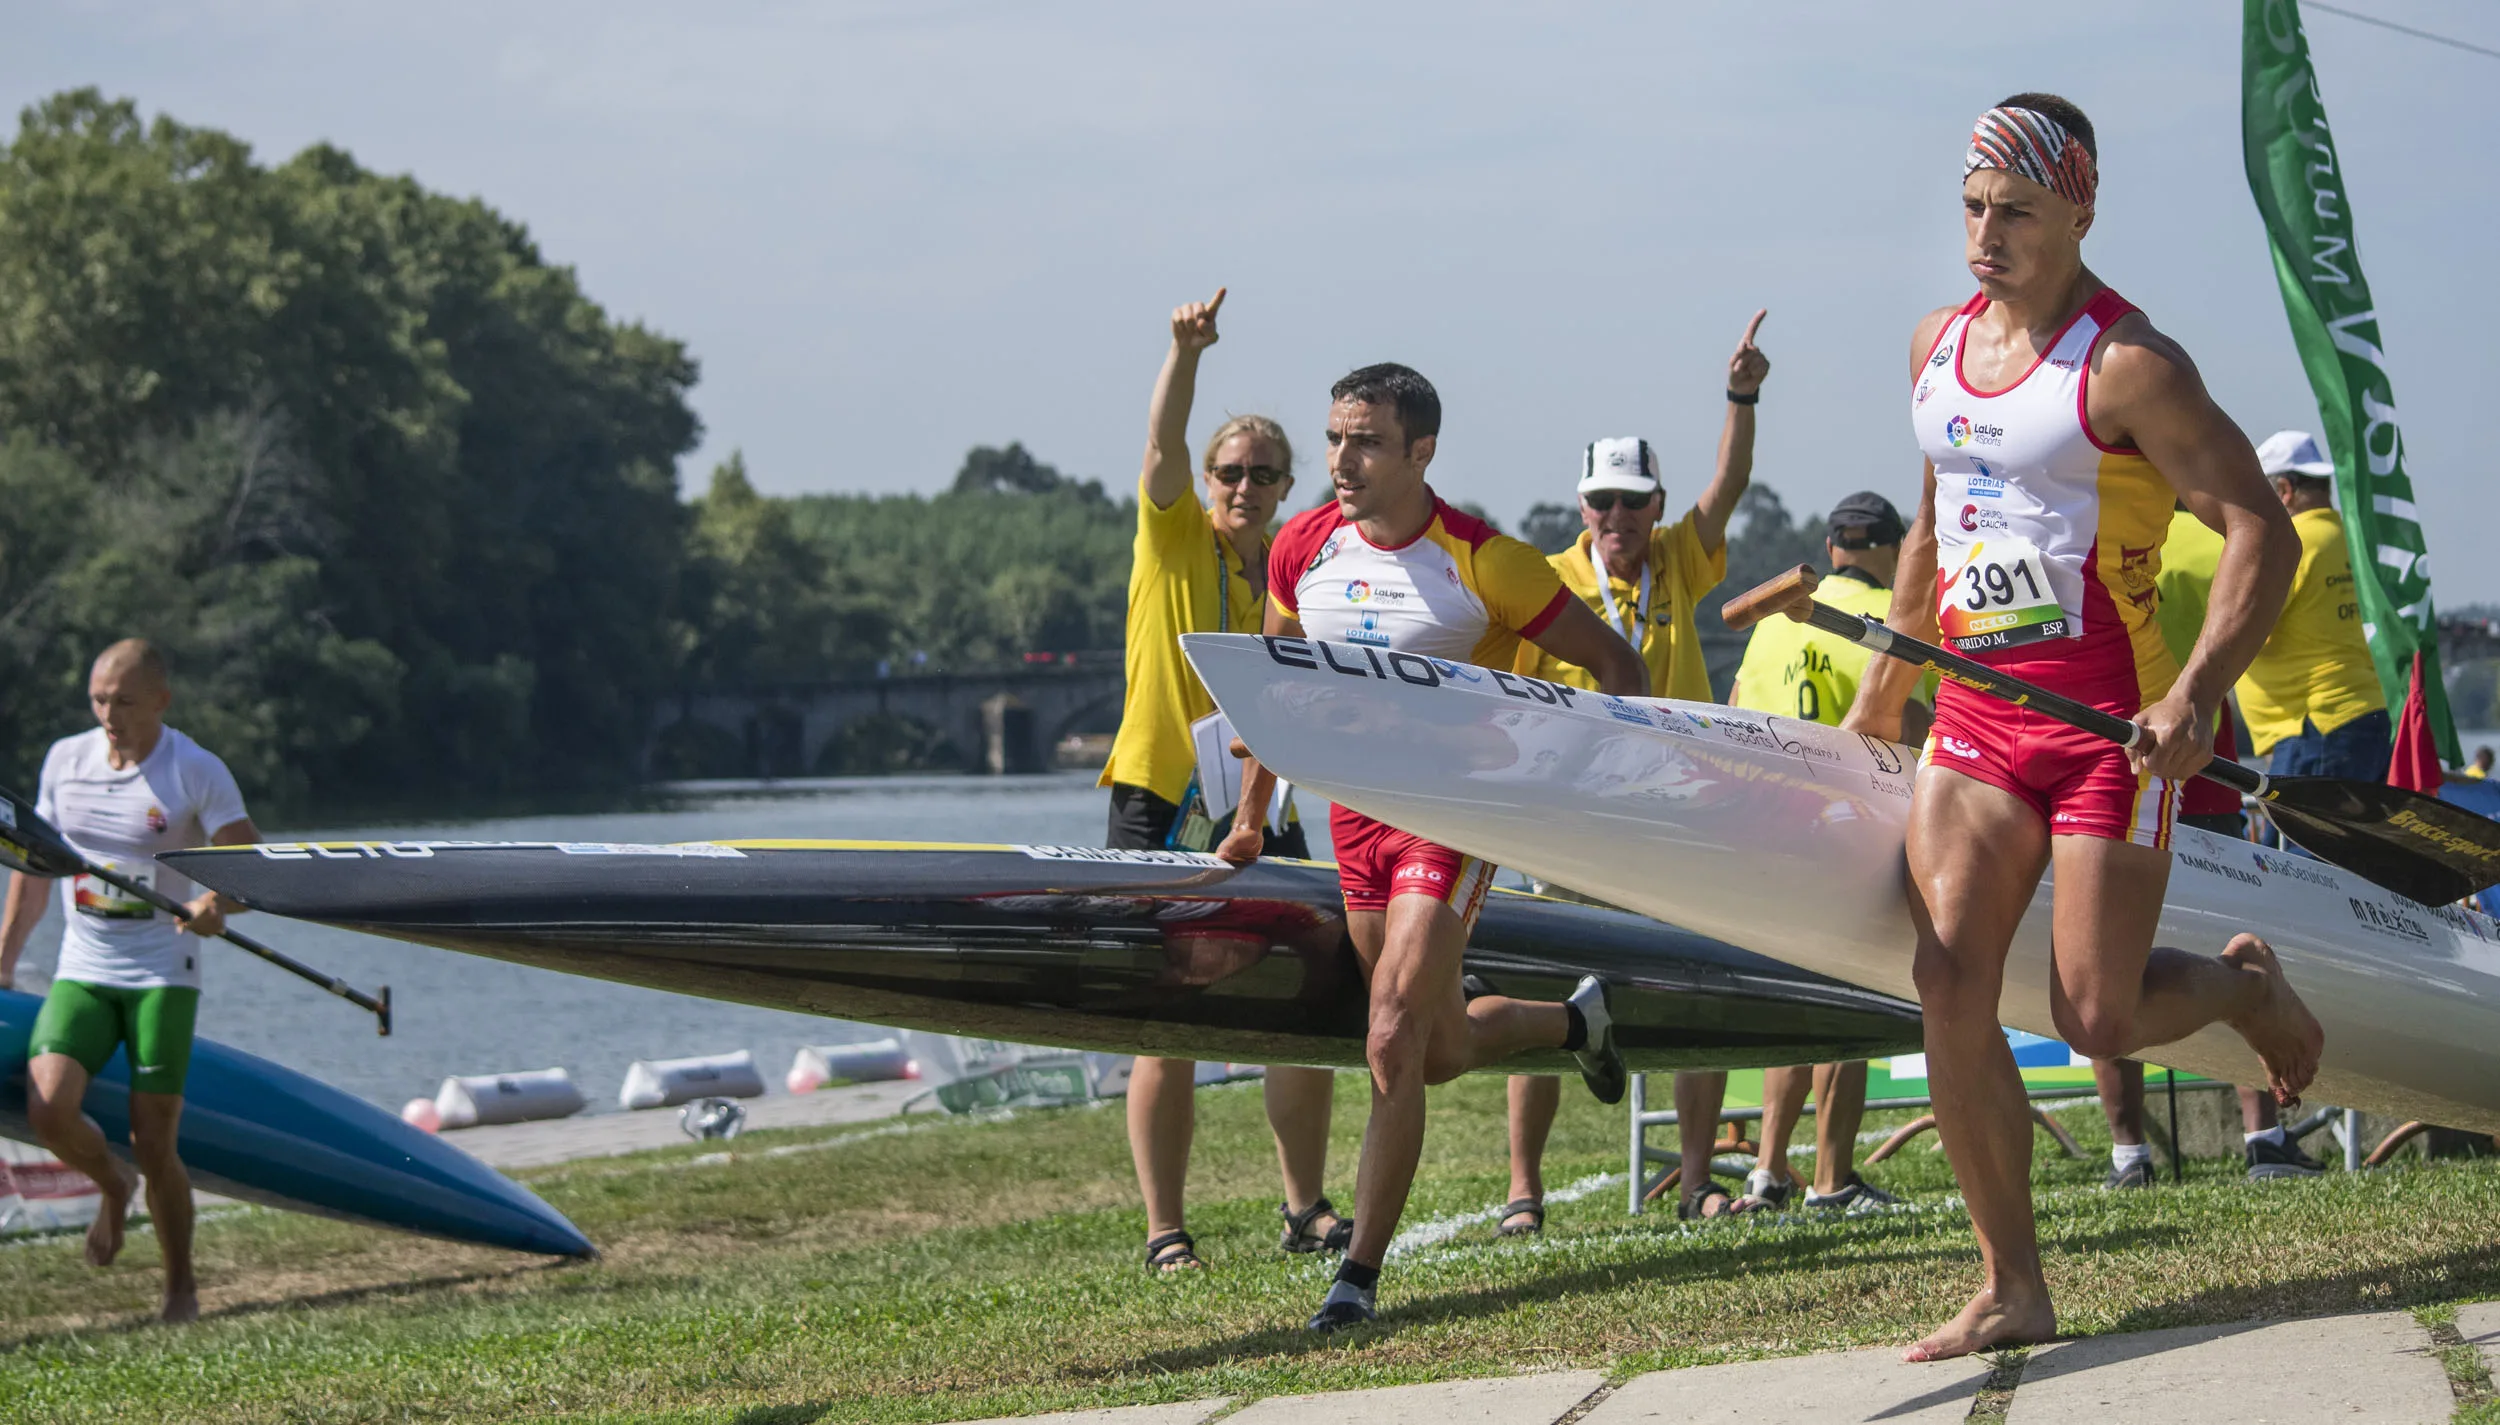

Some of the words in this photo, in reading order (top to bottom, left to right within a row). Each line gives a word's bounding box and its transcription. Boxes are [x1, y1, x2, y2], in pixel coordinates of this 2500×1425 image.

[1974, 423, 2004, 437] LaLiga
[1974, 434, 2002, 446] 4Sports
[1979, 508, 2003, 519] GRUPO
[1966, 558, 2041, 610] 391
[1374, 587, 1405, 599] LaLiga
[1971, 613, 2016, 630] NELO
[1994, 632, 2008, 645] M.
[1263, 635, 1440, 687] ELIO
[1723, 727, 1774, 748] 4Sports
[252, 840, 434, 859] ELIO
[1396, 863, 1442, 881] NELO
